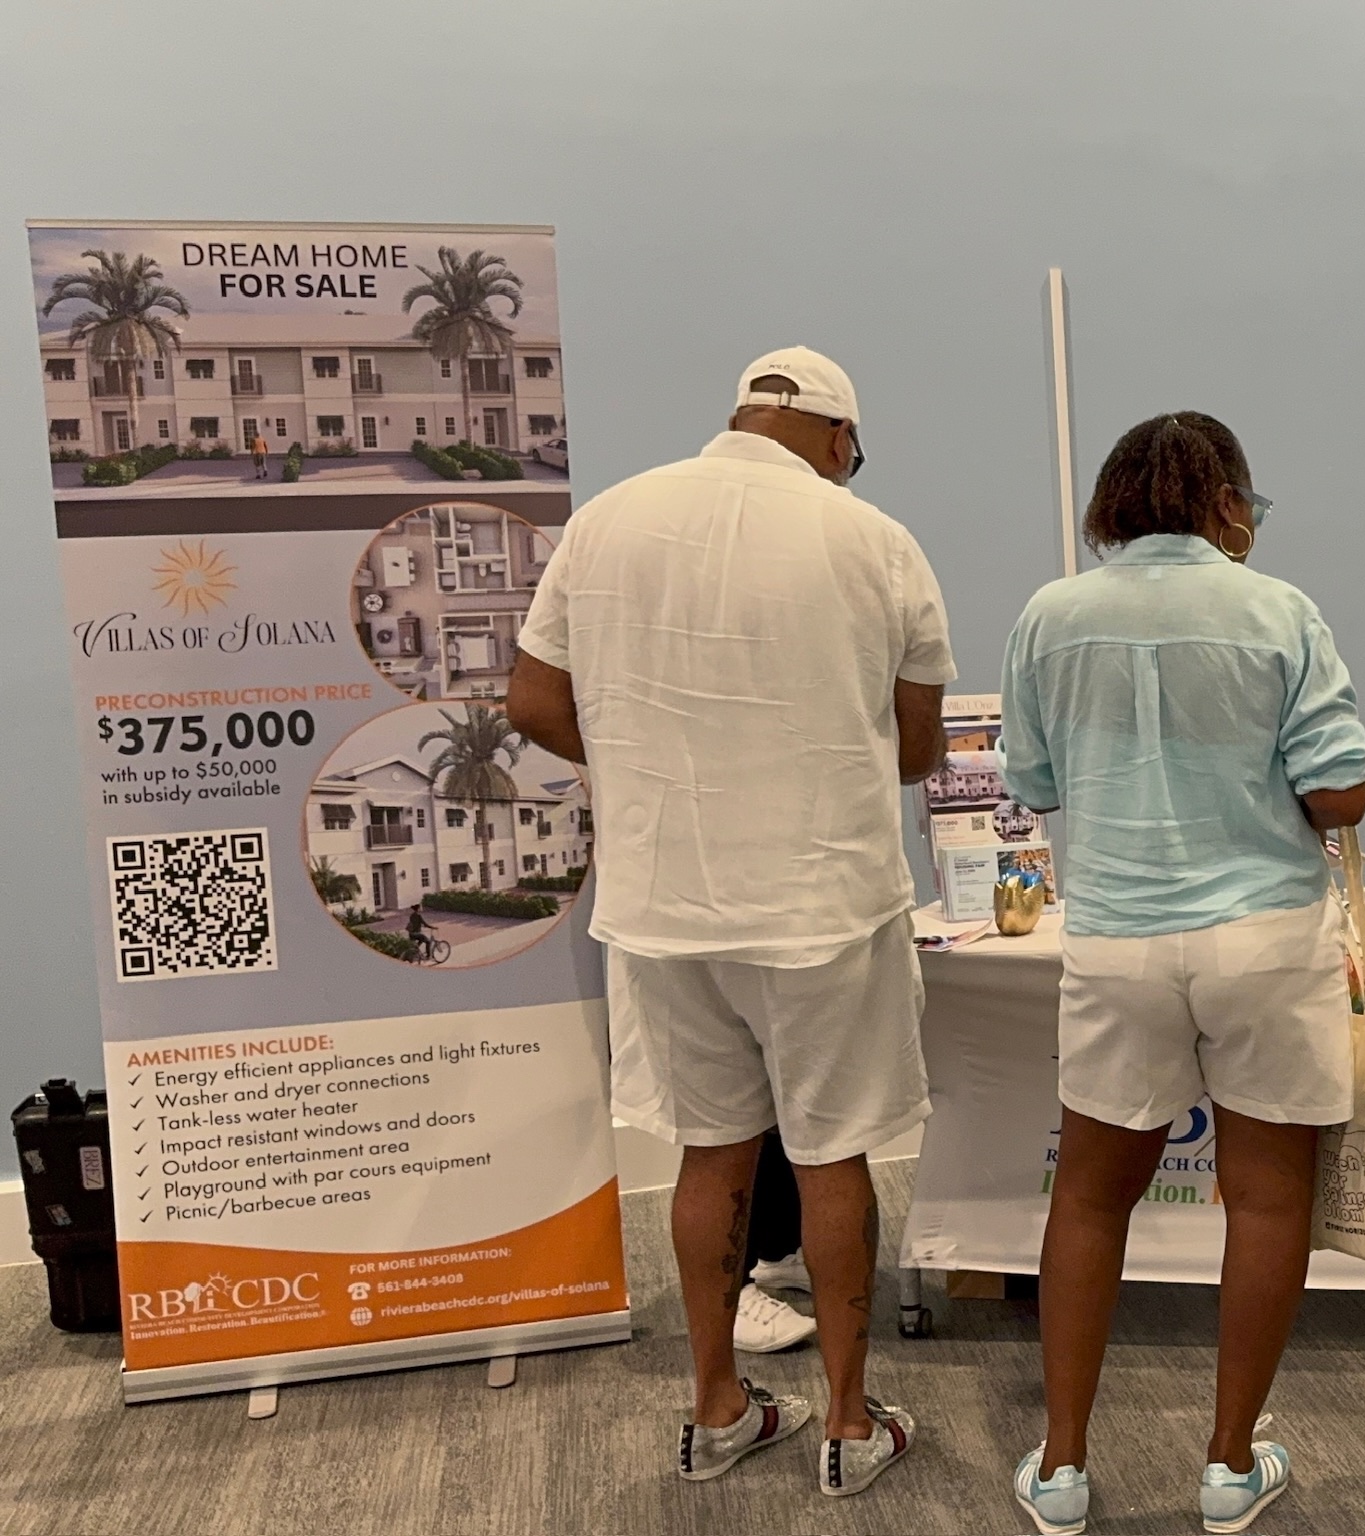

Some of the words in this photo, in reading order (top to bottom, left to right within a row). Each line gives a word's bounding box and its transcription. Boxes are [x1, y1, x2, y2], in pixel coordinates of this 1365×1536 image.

[182, 242, 299, 267] DREAM
[311, 244, 409, 268] HOME
[219, 273, 287, 298] FOR
[295, 273, 377, 298] SALE
[73, 612, 174, 658] VILLAS
[182, 626, 209, 650] OF
[218, 613, 336, 653] SOLANA
[95, 685, 308, 712] PRECONSTRUCTION
[314, 683, 372, 700] PRICE
[98, 709, 315, 757] $375,000
[101, 766, 137, 783] with
[143, 769, 166, 784] up
[171, 766, 189, 780] to
[196, 759, 277, 780] $50,000
[103, 789, 118, 805] in
[124, 784, 191, 805] subsidy
[198, 779, 281, 800] available
[127, 1043, 237, 1068] AMENITIES
[242, 1035, 335, 1057] INCLUDE:
[155, 1070, 218, 1087] Energy
[224, 1062, 293, 1080] efficient
[298, 1054, 395, 1077] appliances
[400, 1046, 434, 1064] and
[439, 1043, 476, 1064] light
[480, 1040, 541, 1057] fixtures
[155, 1089, 229, 1109] Washer
[234, 1082, 269, 1102] and
[274, 1081, 322, 1101] dryer
[326, 1072, 430, 1094] connections
[157, 1110, 241, 1132] Tank-less
[246, 1107, 297, 1123] water
[302, 1101, 359, 1118] heater
[160, 1135, 222, 1156] Impact
[227, 1127, 299, 1148] resistant
[303, 1120, 382, 1140] windows
[387, 1112, 421, 1132] and
[426, 1110, 476, 1127] doors
[162, 1156, 240, 1176] Outdoor
[245, 1143, 364, 1168] entertainment
[369, 1141, 410, 1156] area
[164, 1172, 267, 1200] Playground
[272, 1169, 308, 1187] with
[314, 1169, 344, 1187] par
[349, 1163, 396, 1179] cours
[401, 1152, 492, 1176] equipment
[166, 1195, 317, 1222] Picnic/barbecue
[322, 1188, 371, 1205] areas
[349, 1262, 375, 1275] FOR
[378, 1257, 416, 1272] MORE
[419, 1247, 512, 1267] INFORMATION:
[377, 1273, 464, 1293] 561-844-3408
[380, 1279, 610, 1318] rivierabeachcdc.org/villas-of-solana
